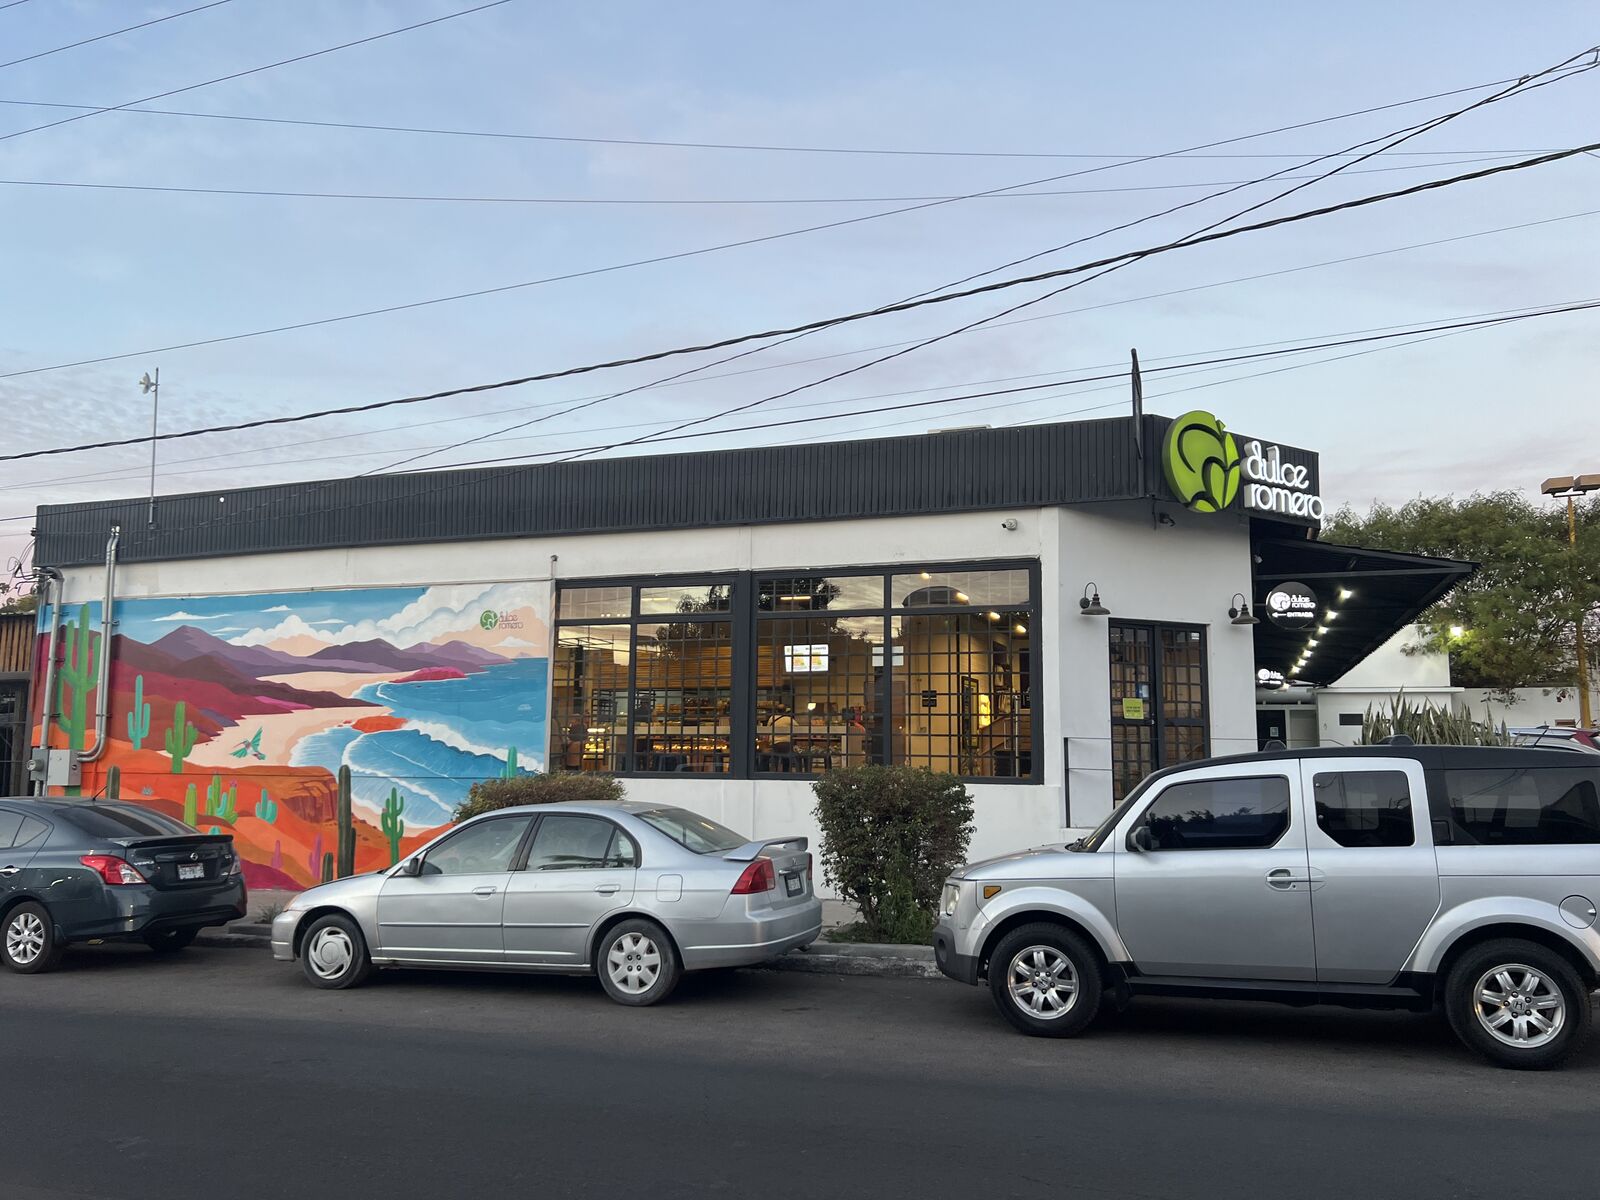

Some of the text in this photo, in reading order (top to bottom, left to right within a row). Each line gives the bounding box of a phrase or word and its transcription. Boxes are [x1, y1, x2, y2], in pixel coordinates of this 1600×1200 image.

[1245, 440, 1310, 489] dulce
[1245, 482, 1324, 519] romero
[498, 621, 524, 630] romero
[499, 611, 519, 622] dulce
